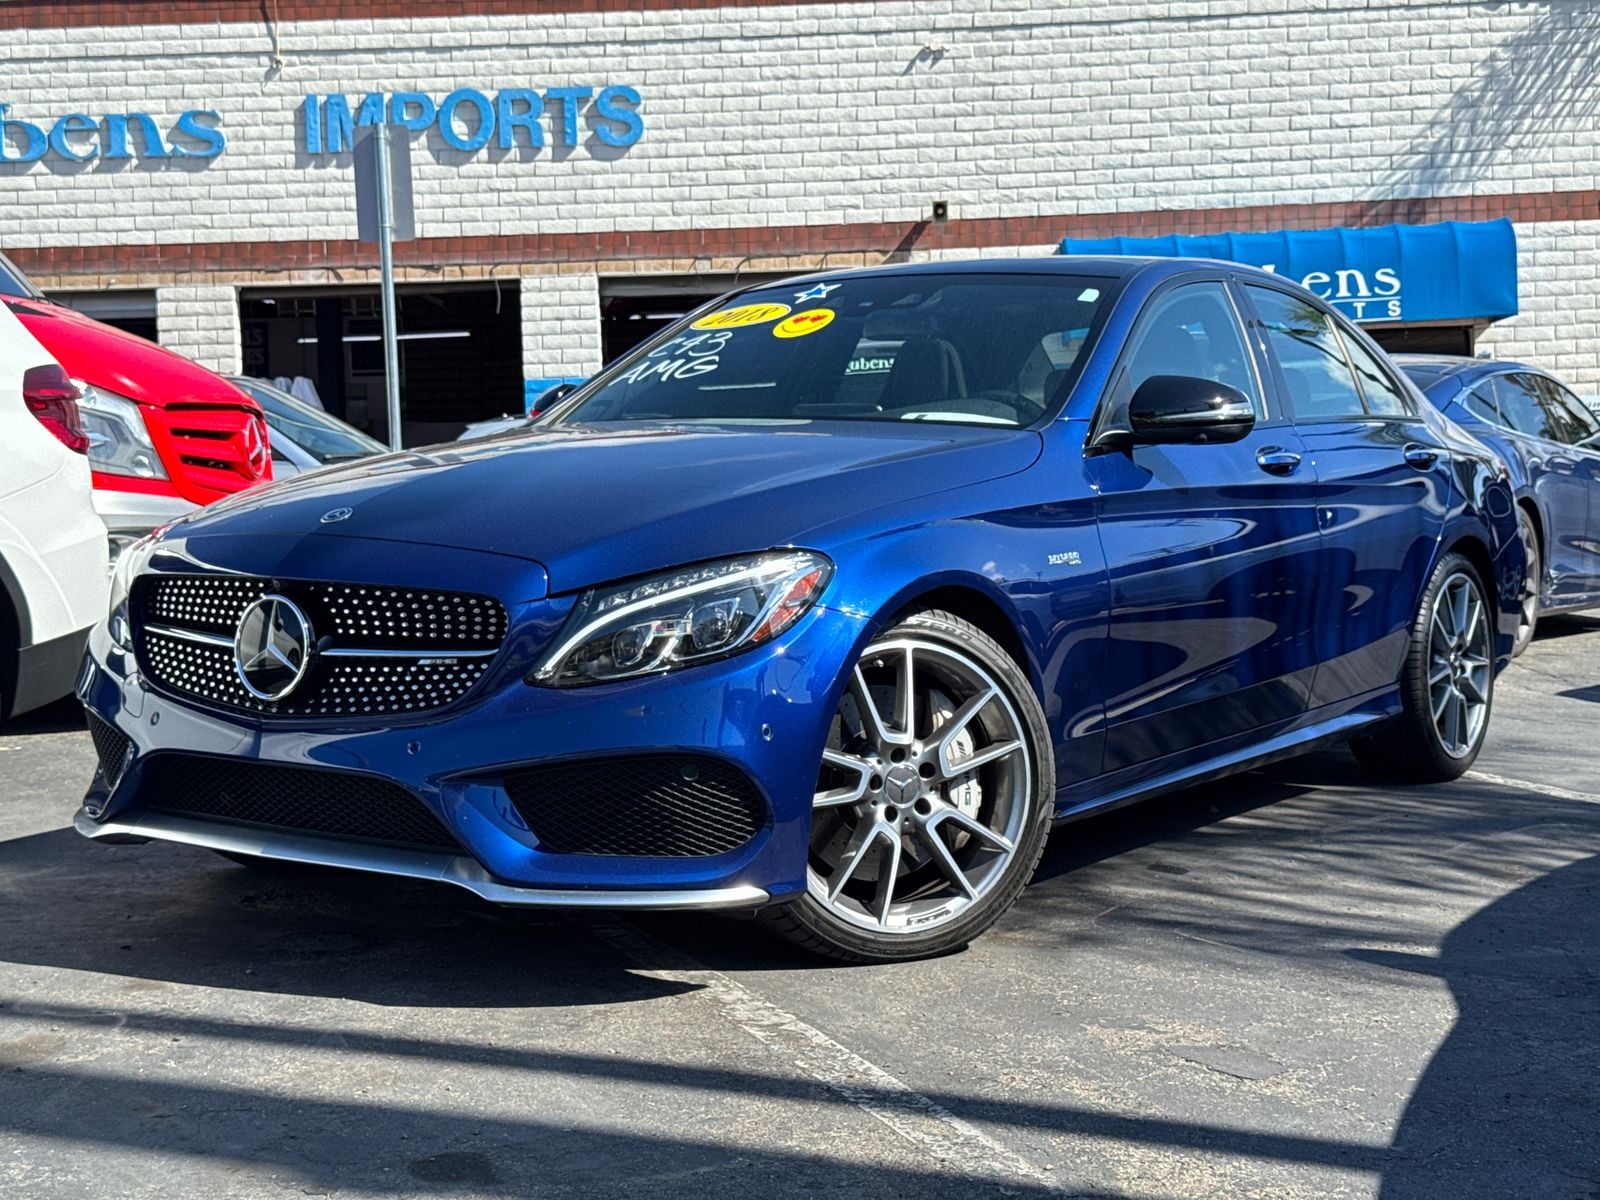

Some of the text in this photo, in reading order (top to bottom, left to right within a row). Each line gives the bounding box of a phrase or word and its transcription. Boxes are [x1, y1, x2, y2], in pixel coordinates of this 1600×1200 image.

[0, 84, 645, 162] bens IMPORTS
[701, 306, 781, 327] 2018
[647, 331, 733, 357] C43
[607, 355, 720, 387] AMG
